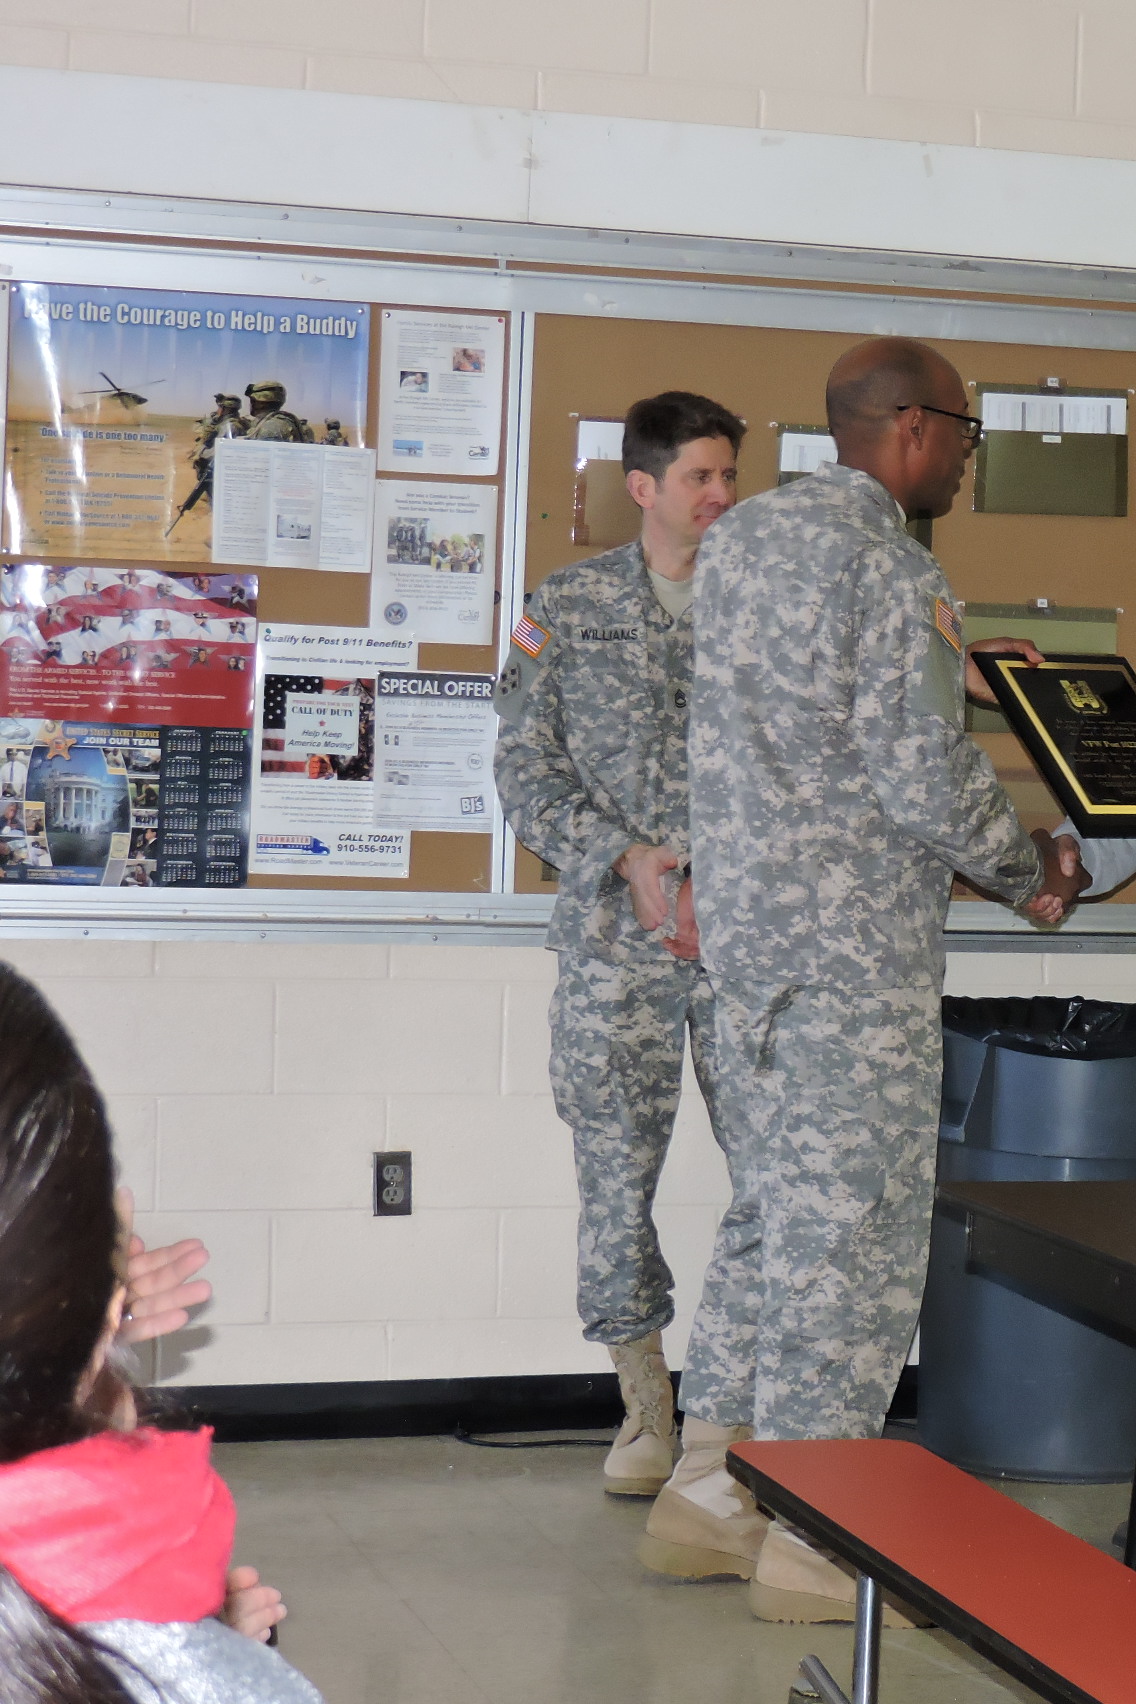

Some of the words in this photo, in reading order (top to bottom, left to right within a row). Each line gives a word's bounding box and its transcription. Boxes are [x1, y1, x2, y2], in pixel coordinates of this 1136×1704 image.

[79, 301, 112, 323] the
[116, 303, 201, 329] Courage
[206, 310, 226, 329] to
[231, 310, 275, 334] Help
[279, 316, 291, 333] a
[296, 314, 357, 339] Buddy
[105, 432, 122, 440] one
[123, 431, 138, 440] too
[580, 628, 638, 641] WILLIAMS
[264, 634, 300, 645] Qualify
[301, 635, 316, 644] for
[318, 636, 339, 646] Post
[342, 637, 363, 647] 9/11
[366, 638, 413, 649] Benefits?
[381, 678, 441, 695] SPECIAL
[444, 681, 492, 697] OFFER
[382, 699, 417, 707] SAVINGS
[291, 706, 312, 714] CALL
[317, 707, 328, 715] OF
[331, 708, 354, 716] DUTY
[301, 730, 320, 738] Help
[322, 731, 342, 739] Keep
[83, 737, 107, 745] JOIN
[109, 738, 130, 746] OUR
[132, 738, 159, 746] TEAM
[288, 739, 321, 748] America
[324, 741, 355, 750] Moving!
[462, 797, 484, 813] BJ's
[259, 835, 310, 844] ROADMASTER
[338, 833, 364, 842] CALL
[367, 834, 404, 843] TODAY!
[337, 844, 403, 854] 910-556-9731
